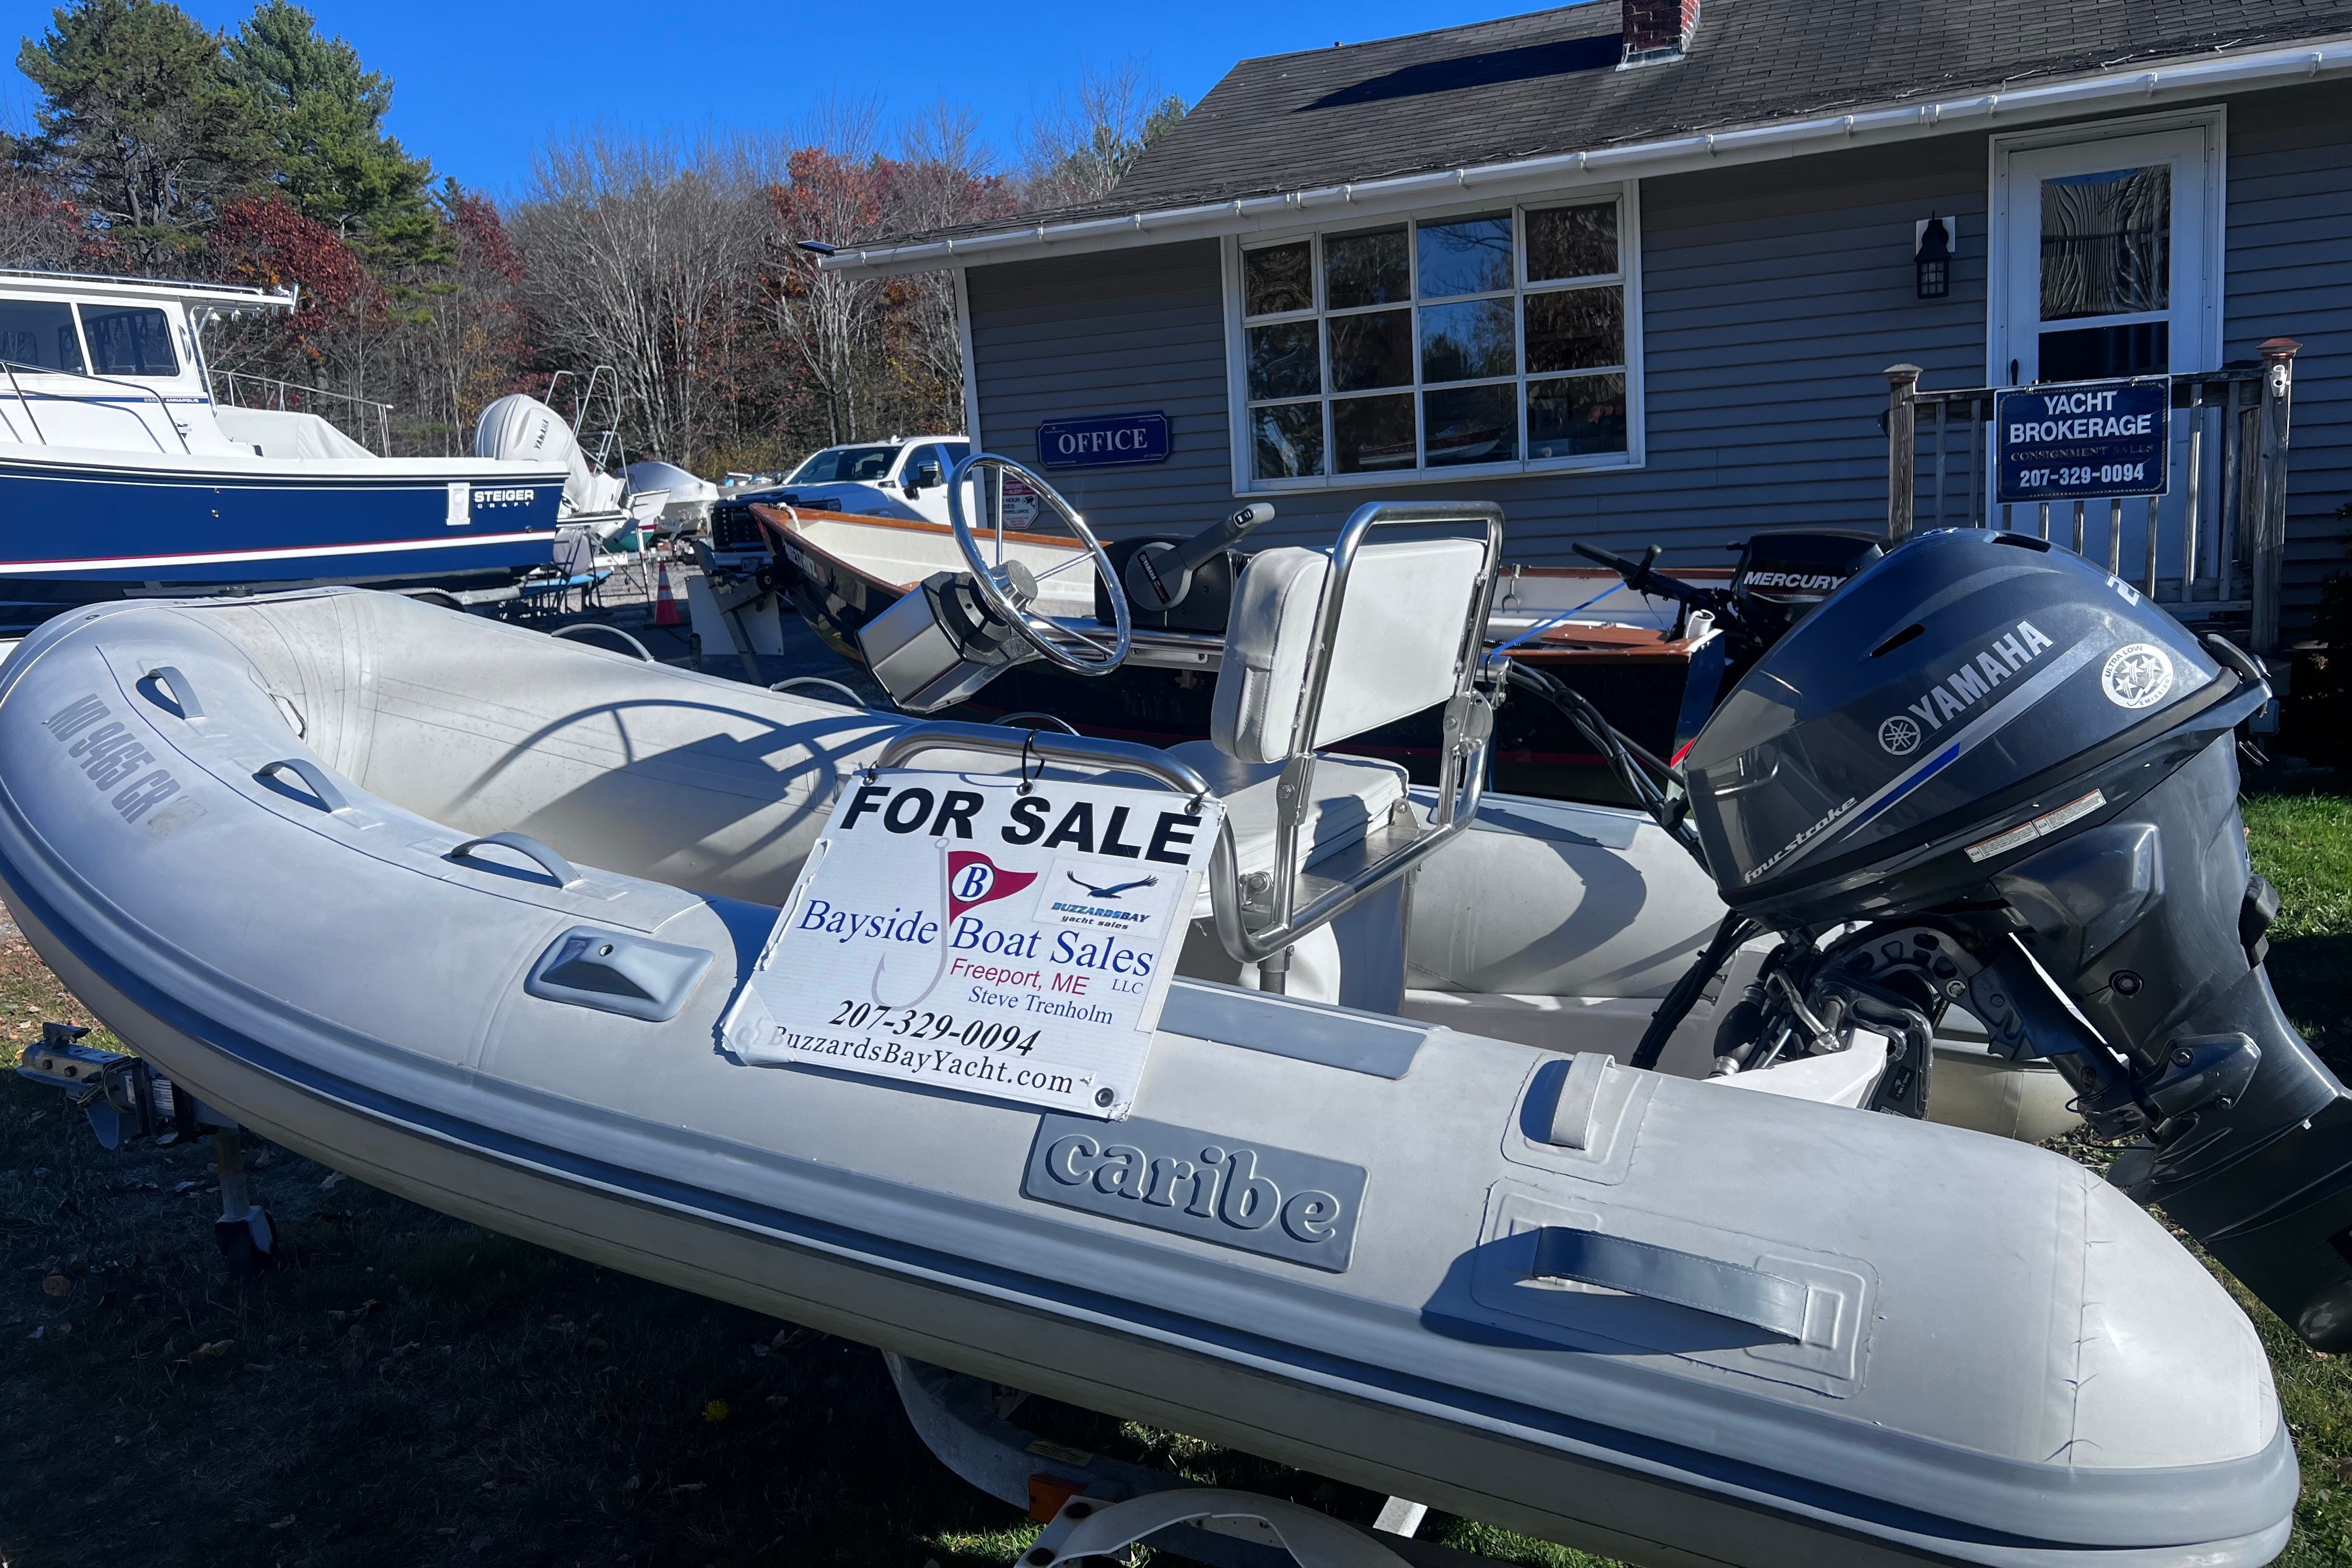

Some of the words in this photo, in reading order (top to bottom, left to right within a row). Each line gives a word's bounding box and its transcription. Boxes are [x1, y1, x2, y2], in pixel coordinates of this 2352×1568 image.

[2043, 390, 2118, 415] YACHT
[533, 419, 550, 450] YAMAHA
[1058, 428, 1147, 454] OFFICE
[2010, 414, 2151, 443] BROKERAGE
[2011, 446, 2108, 462] CONSIGNMENT
[2113, 444, 2154, 454] SALES
[2020, 463, 2146, 488] 207-329-0094
[474, 489, 534, 502] STEIGER
[1143, 559, 1156, 580] YAMAHA
[1743, 571, 1847, 590] MERCURY
[1908, 620, 2053, 730] YAMAHA
[2105, 654, 2123, 677] ULTRA
[2122, 645, 2143, 656] LOW
[2139, 678, 2170, 706] EMISSION
[68, 722, 156, 791] 9465
[111, 769, 180, 824] CR
[839, 786, 984, 839] FOR
[1001, 796, 1202, 866] SALE
[957, 866, 988, 898] B
[1051, 902, 1151, 923] BUZZARDSBAY
[1060, 915, 1094, 926] yacht
[1097, 920, 1129, 930] sales
[796, 900, 938, 944] Bayside
[949, 916, 1042, 958] Boat
[1049, 930, 1153, 977] Sales
[950, 958, 1042, 991] Freeport,
[1051, 973, 1090, 995] ME
[1111, 979, 1143, 994] LLC
[968, 986, 1019, 1008] Steve
[1026, 994, 1112, 1024] Trenholm
[828, 1000, 1042, 1056] 207-329-0094
[769, 1026, 1073, 1093] BuzzardsBayYacht.com
[1045, 1133, 1340, 1243] caribe
